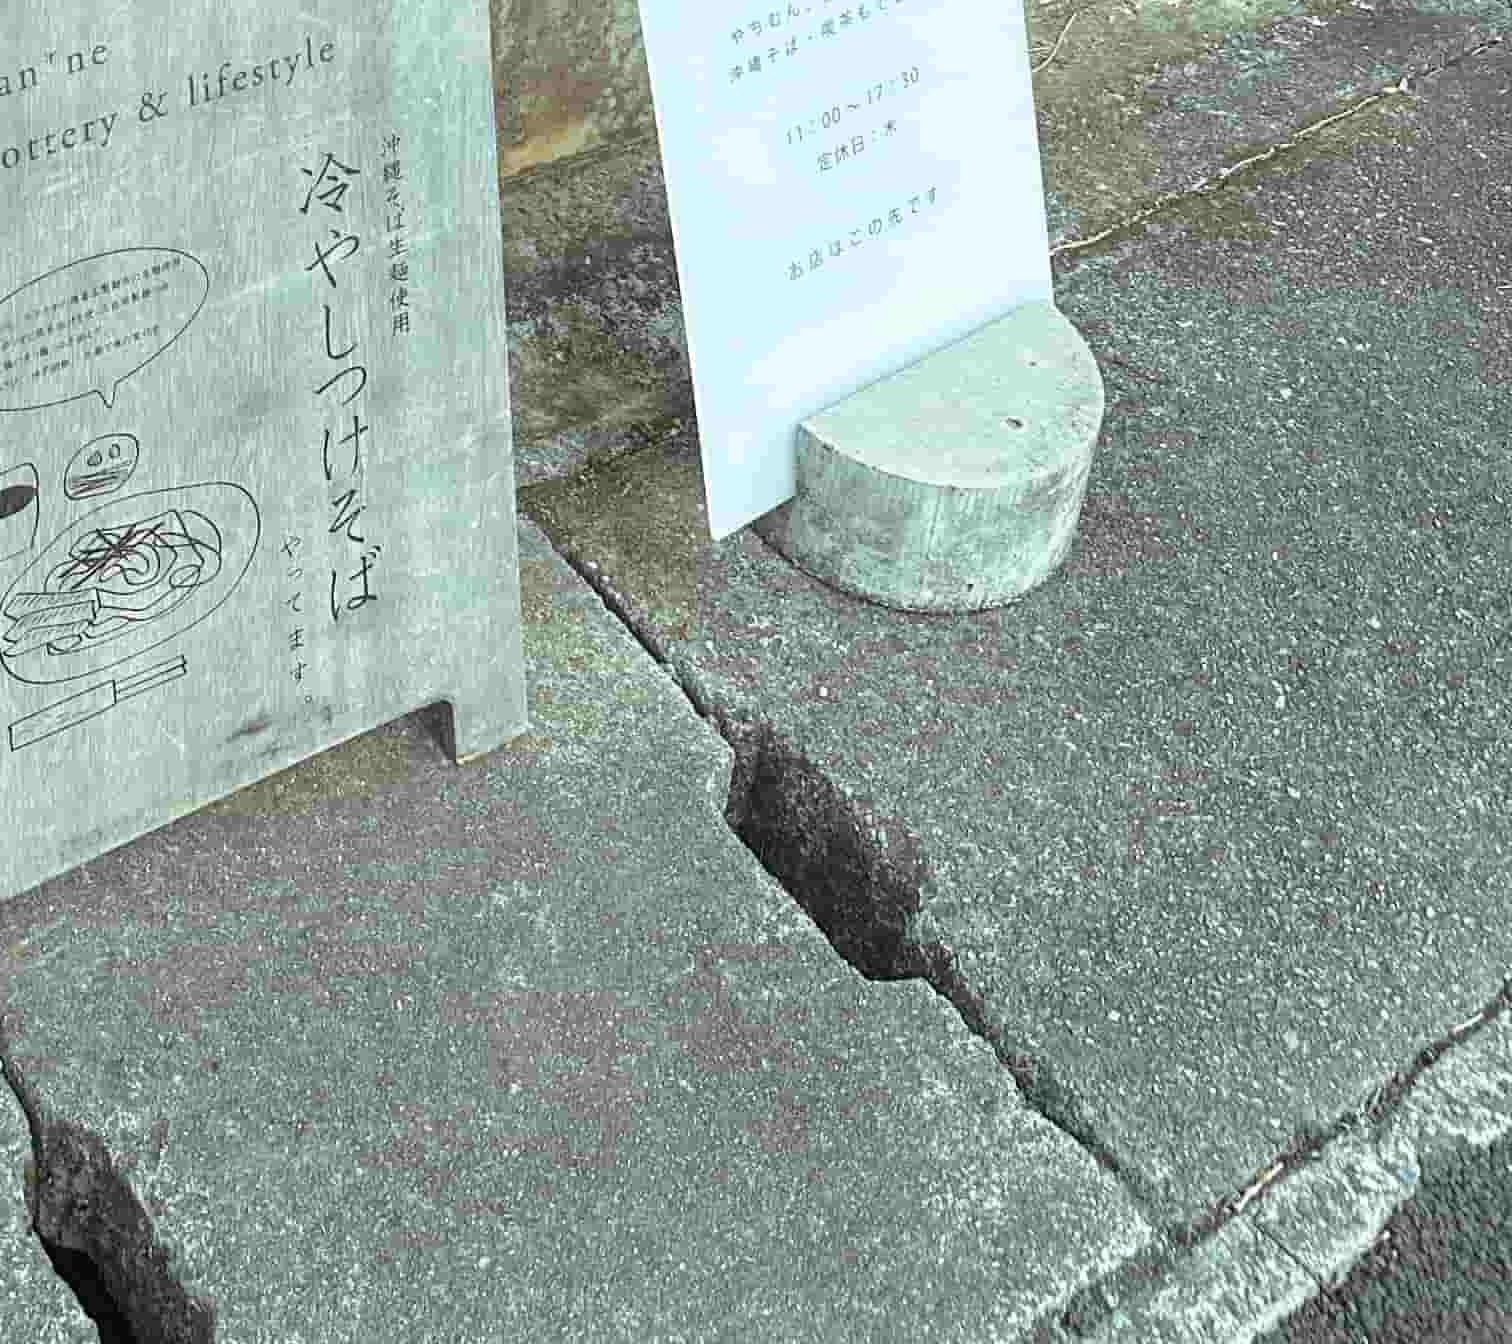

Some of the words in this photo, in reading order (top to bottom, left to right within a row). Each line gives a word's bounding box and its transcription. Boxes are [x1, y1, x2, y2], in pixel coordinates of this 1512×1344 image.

[138, 89, 168, 122] &
[187, 36, 336, 106] lifestyle
[299, 152, 381, 621] 冷やしつけそば
